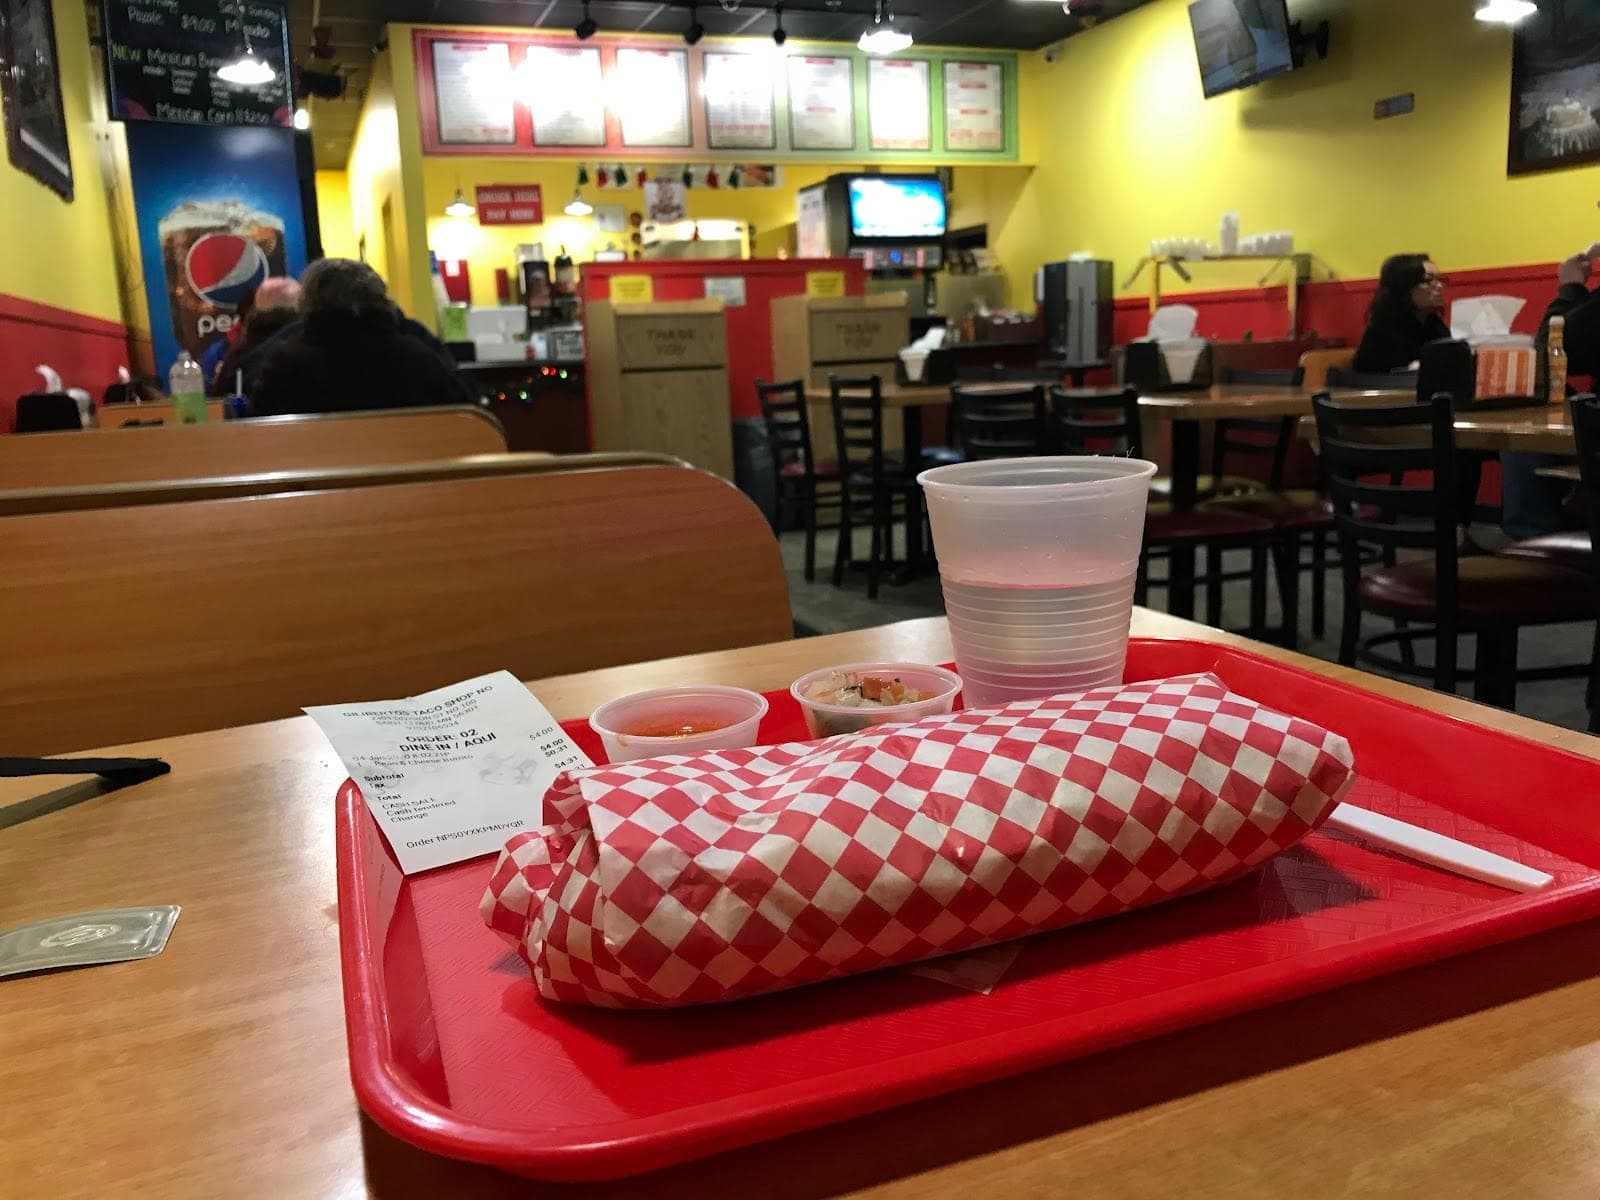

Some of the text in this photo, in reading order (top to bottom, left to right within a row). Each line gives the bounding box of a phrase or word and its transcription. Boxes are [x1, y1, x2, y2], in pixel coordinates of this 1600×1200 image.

[413, 705, 443, 716] TACO
[445, 692, 474, 707] SHOP
[476, 685, 493, 695] NO
[406, 728, 479, 743] ORDER: 02
[529, 726, 554, 741] $4.00
[400, 732, 497, 752] DINE IN / AQUI
[540, 738, 564, 751] $4.00
[554, 755, 578, 769] $4.31
[364, 772, 405, 782] Subtotal
[377, 793, 402, 801] Total
[386, 807, 412, 817] Cash
[390, 812, 429, 823] Change
[406, 838, 434, 848] Order
